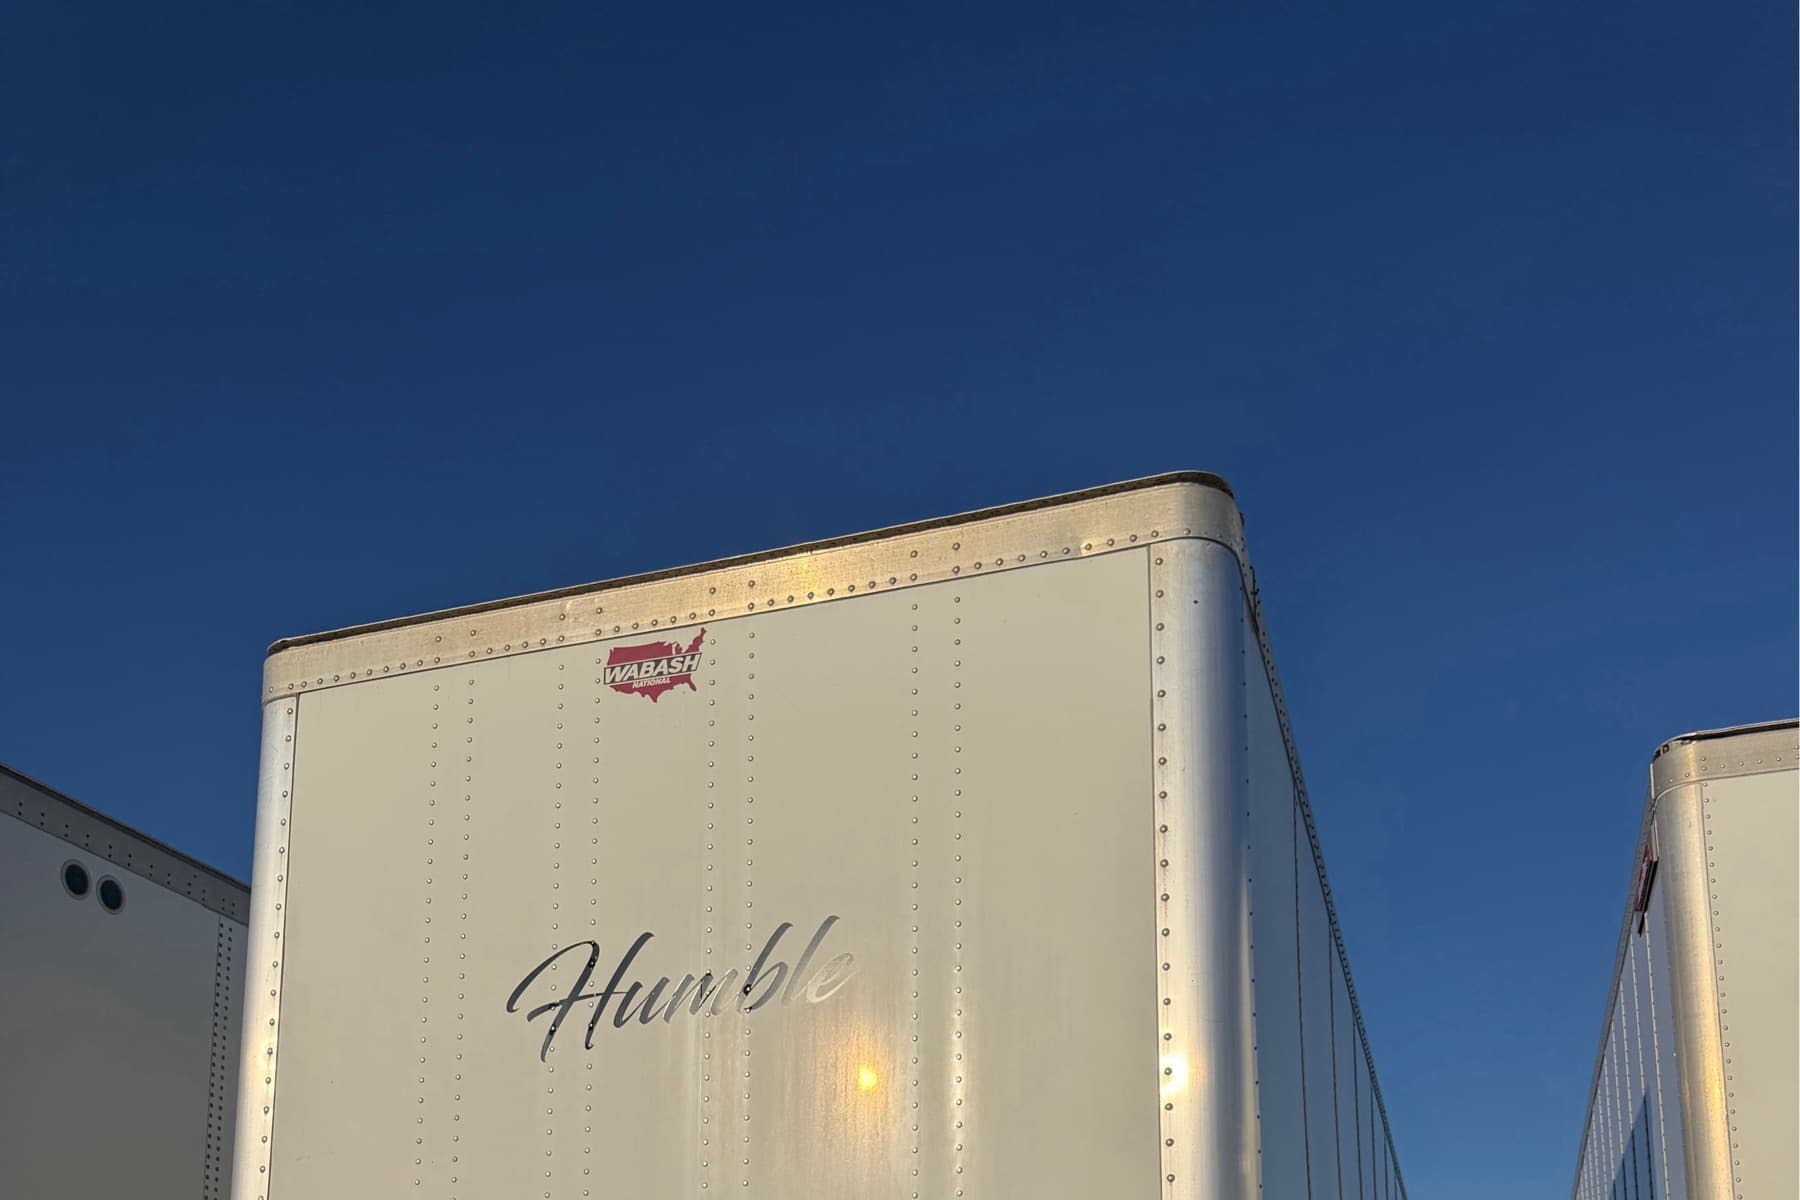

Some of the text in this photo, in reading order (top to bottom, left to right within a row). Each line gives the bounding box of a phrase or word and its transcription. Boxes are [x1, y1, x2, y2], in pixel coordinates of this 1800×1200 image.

[605, 653, 701, 684] WABASH
[632, 676, 671, 688] NATIONAL
[506, 915, 854, 1063] Humble
